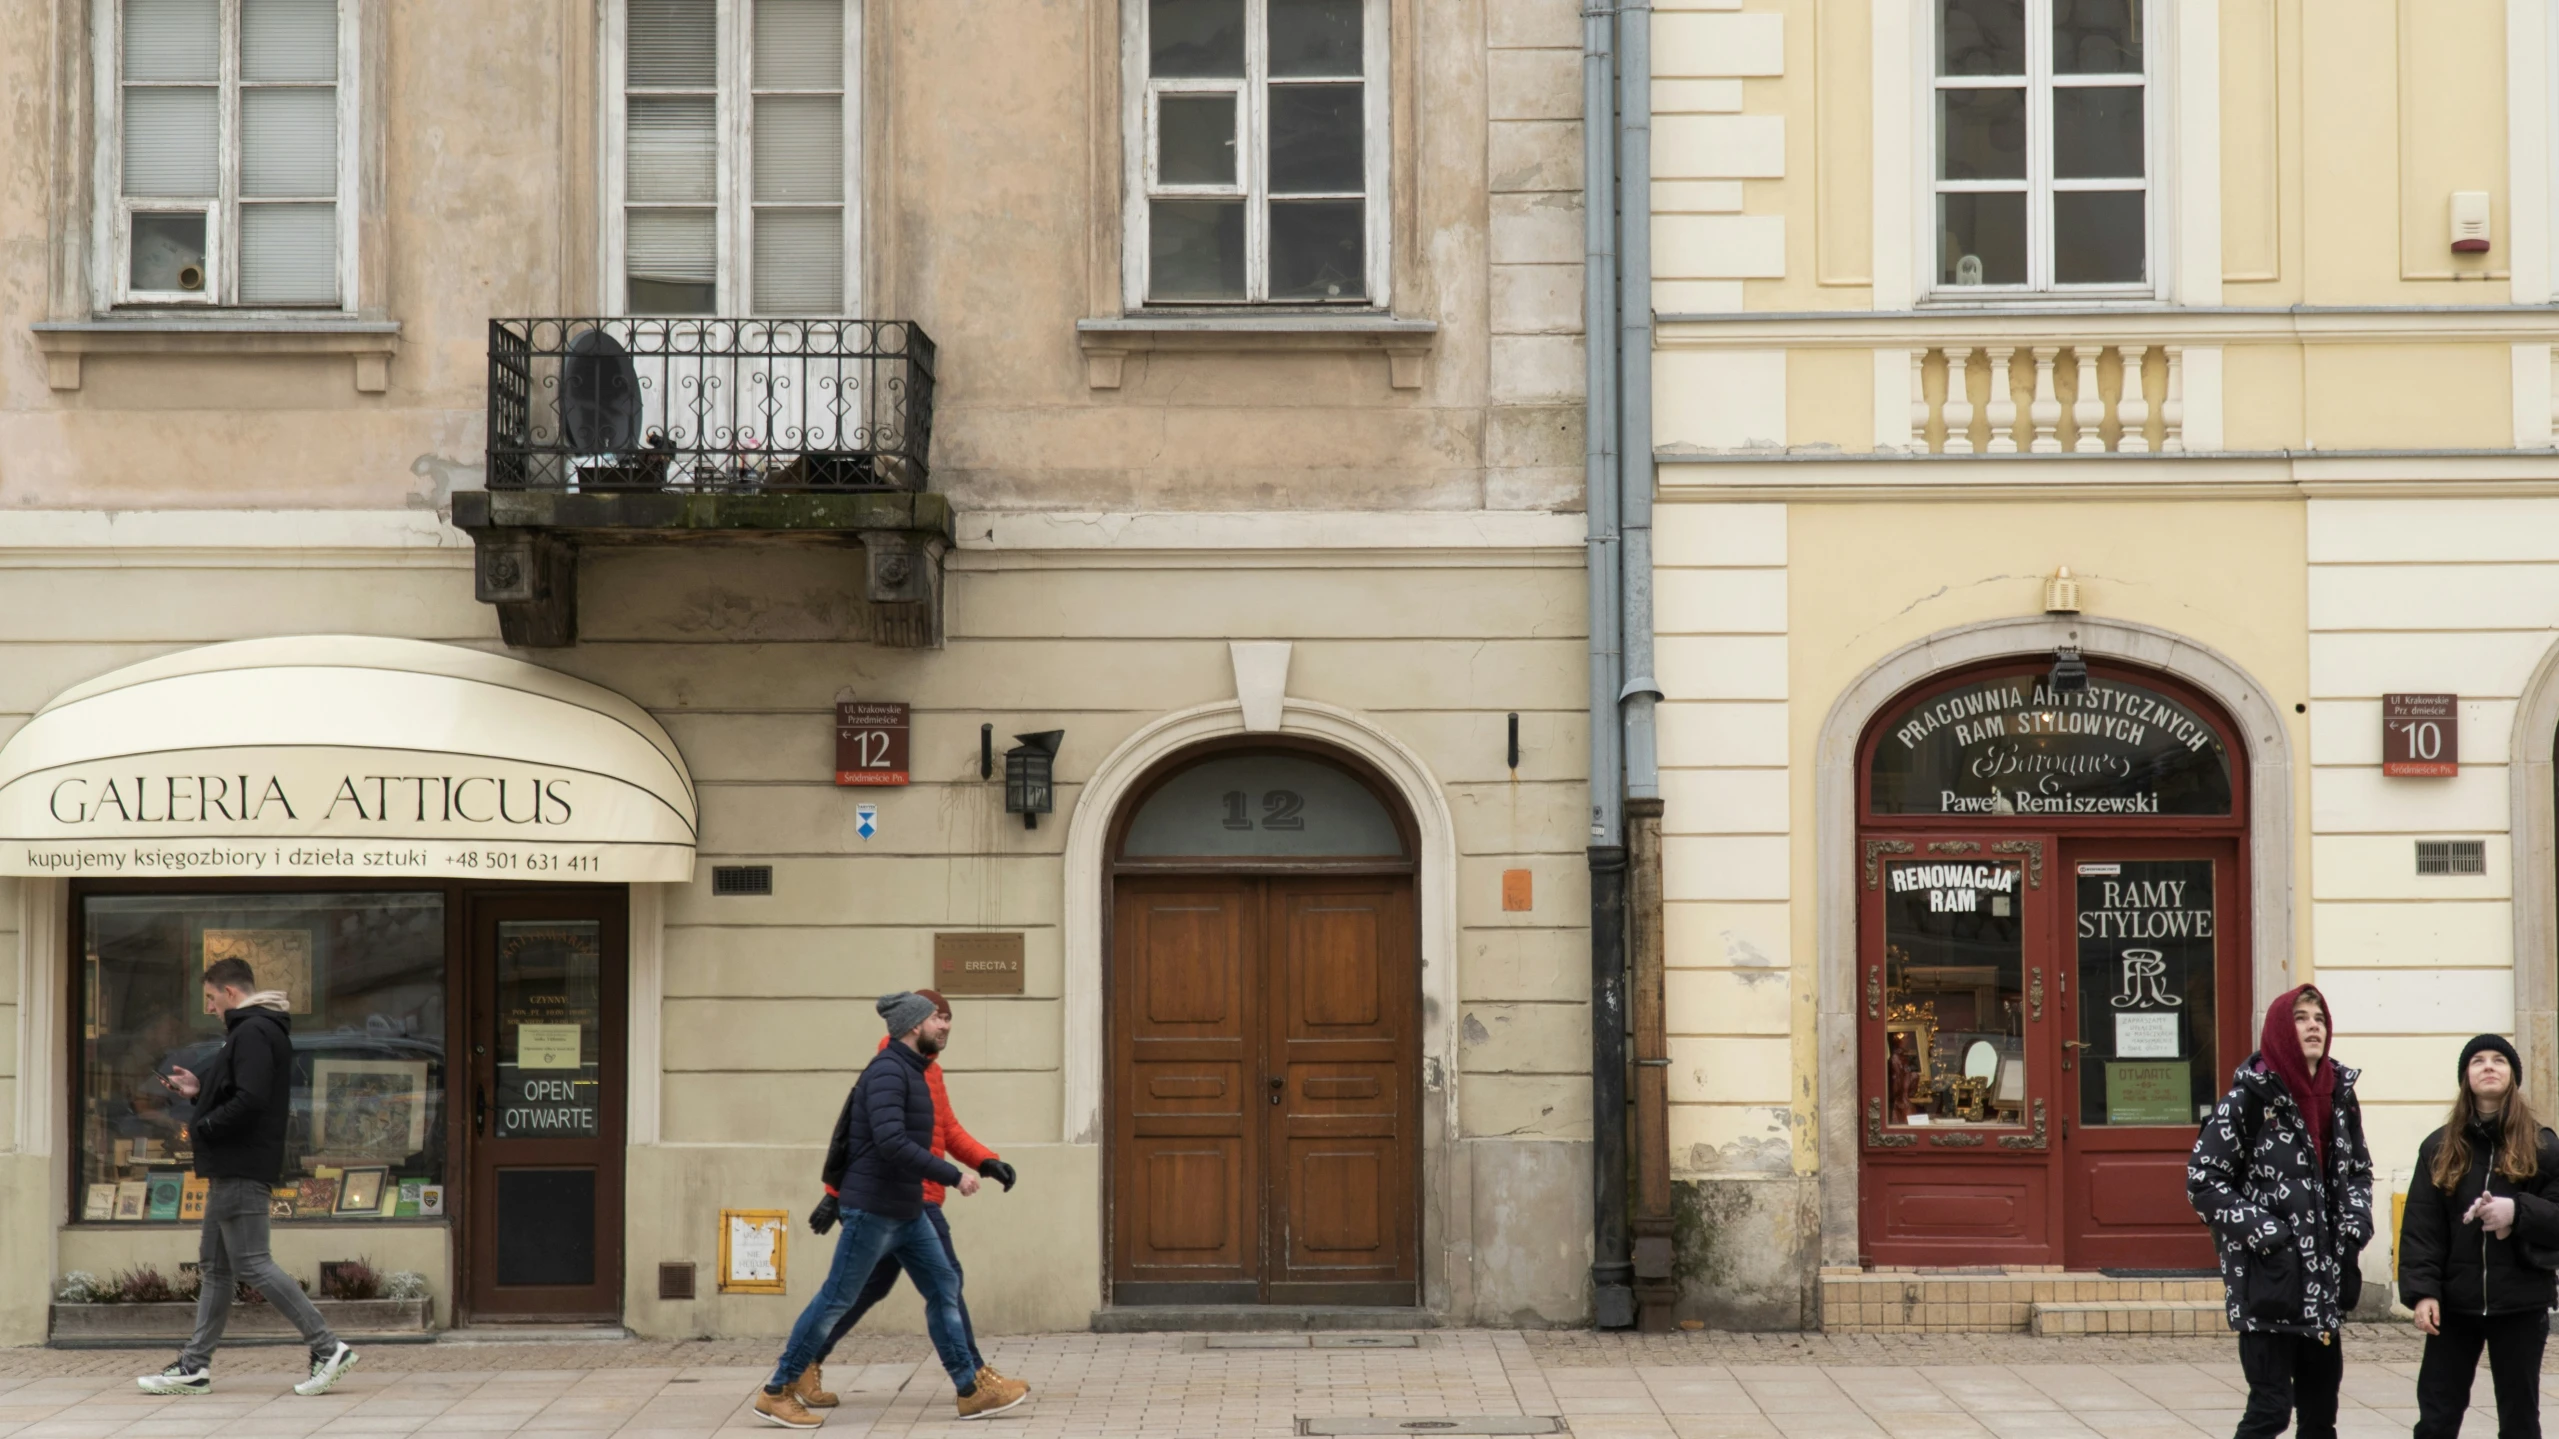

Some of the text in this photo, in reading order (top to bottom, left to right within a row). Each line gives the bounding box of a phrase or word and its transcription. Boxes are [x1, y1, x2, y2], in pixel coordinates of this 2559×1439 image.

[844, 704, 901, 714] Ul. Krakowskie
[2405, 695, 2449, 705] Krakowskie
[848, 715, 898, 725] Przedmieście
[1897, 687, 2023, 749] PRACOWNIA
[1955, 711, 2145, 747] RAM STYLOWYCH
[853, 730, 891, 768] 12
[2401, 721, 2441, 760] 10
[844, 772, 905, 783] Śródmieście Pn.
[2390, 765, 2438, 775] Śródmieście
[49, 775, 573, 826] GALERIA ATTICUS
[1222, 789, 1305, 831] 12
[2016, 791, 2158, 813] Remiszewski
[28, 849, 600, 872] kupujemy księgozbiory i dzieła sztuki +48 501 631 411
[1892, 865, 2012, 893] RENOWACJA
[1930, 890, 1976, 912] RAM
[2103, 881, 2186, 909] RAMY
[2079, 910, 2213, 939] STYLOWE
[965, 961, 1007, 970] ERECTA
[1011, 961, 1017, 970] 2
[524, 1080, 575, 1101] OPEN
[505, 1108, 593, 1129] OTWARTE
